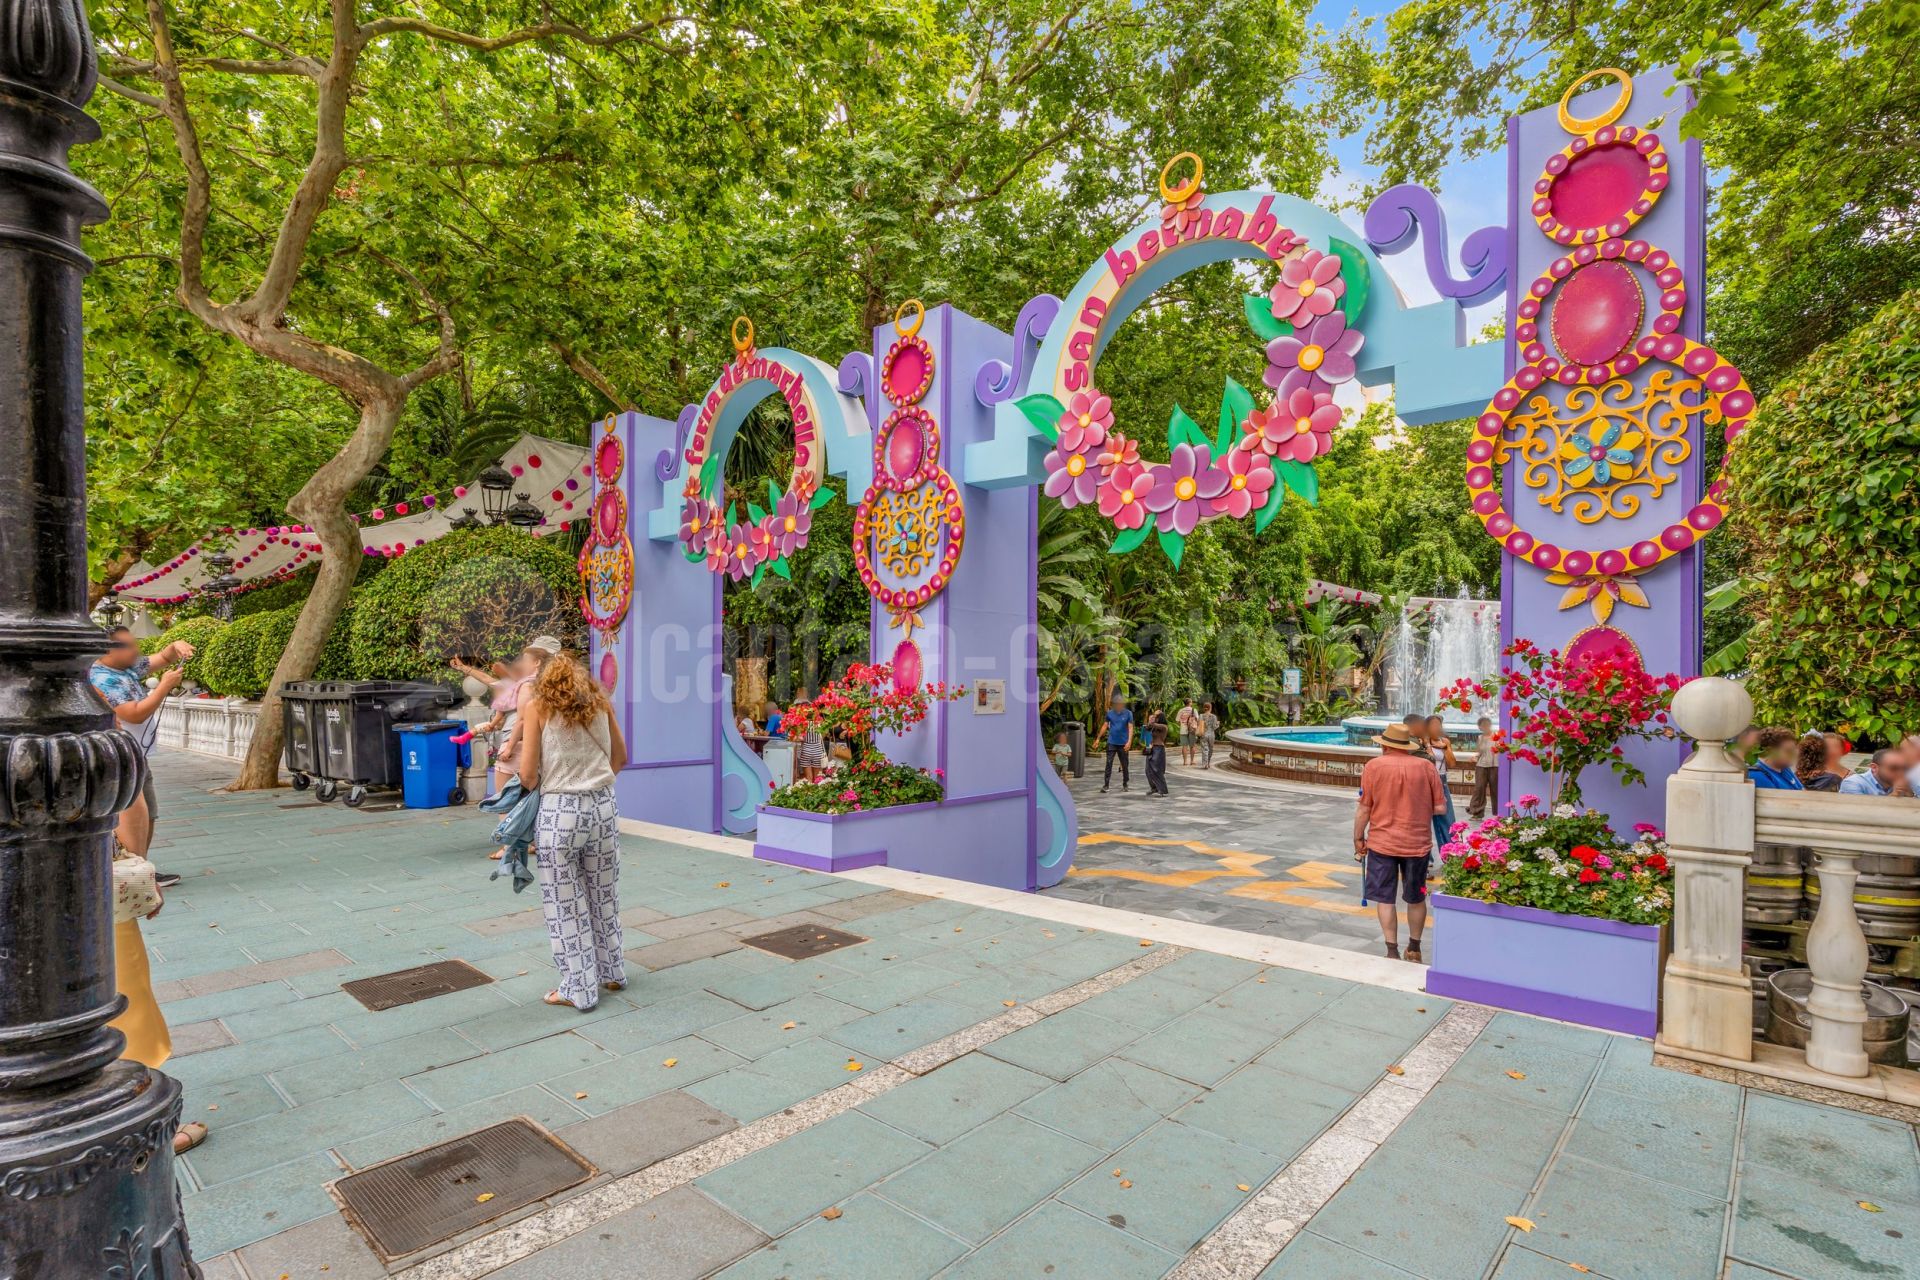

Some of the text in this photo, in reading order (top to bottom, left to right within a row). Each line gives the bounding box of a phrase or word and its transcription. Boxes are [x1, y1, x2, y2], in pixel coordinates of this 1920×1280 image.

[1063, 296, 1107, 392] san
[684, 357, 815, 468] feria de marbella
